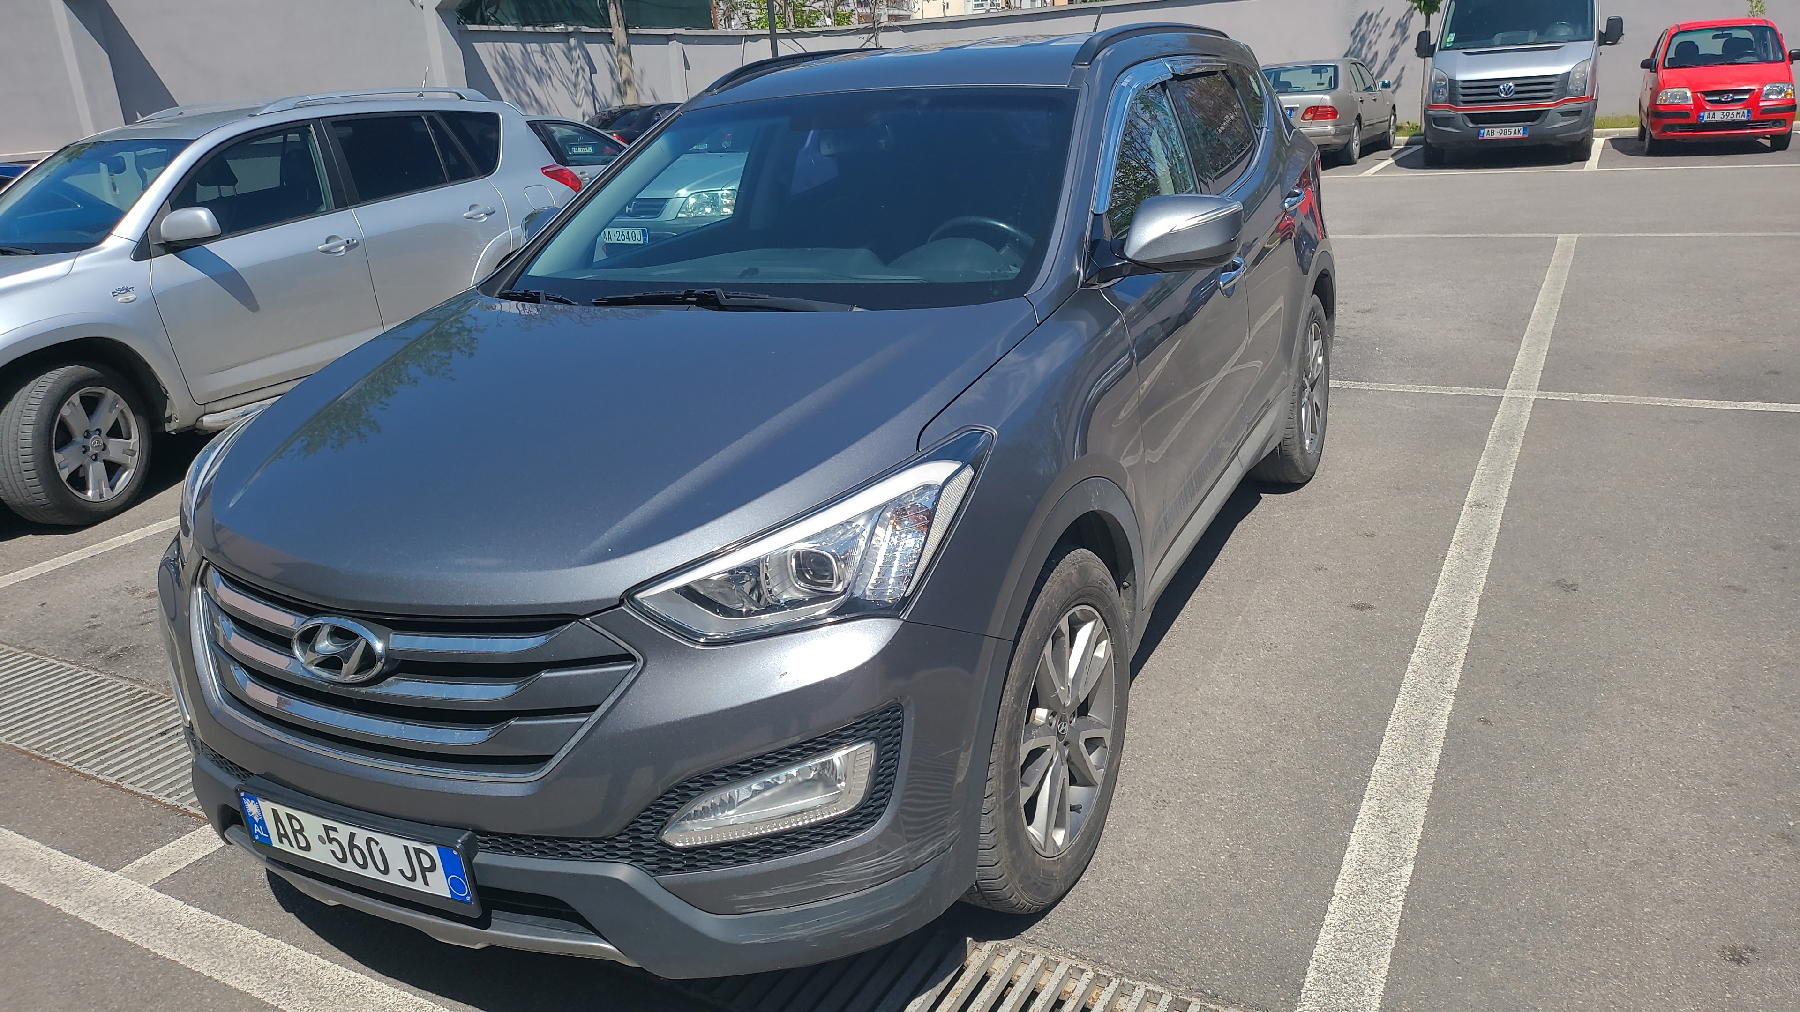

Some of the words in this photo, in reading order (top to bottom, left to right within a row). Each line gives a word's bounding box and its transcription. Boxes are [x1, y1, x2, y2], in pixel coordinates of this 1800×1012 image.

[1706, 111, 1716, 120] AA
[1485, 129, 1495, 137] AB
[254, 823, 269, 838] AL
[271, 808, 311, 852] AB
[398, 844, 437, 887] JP
